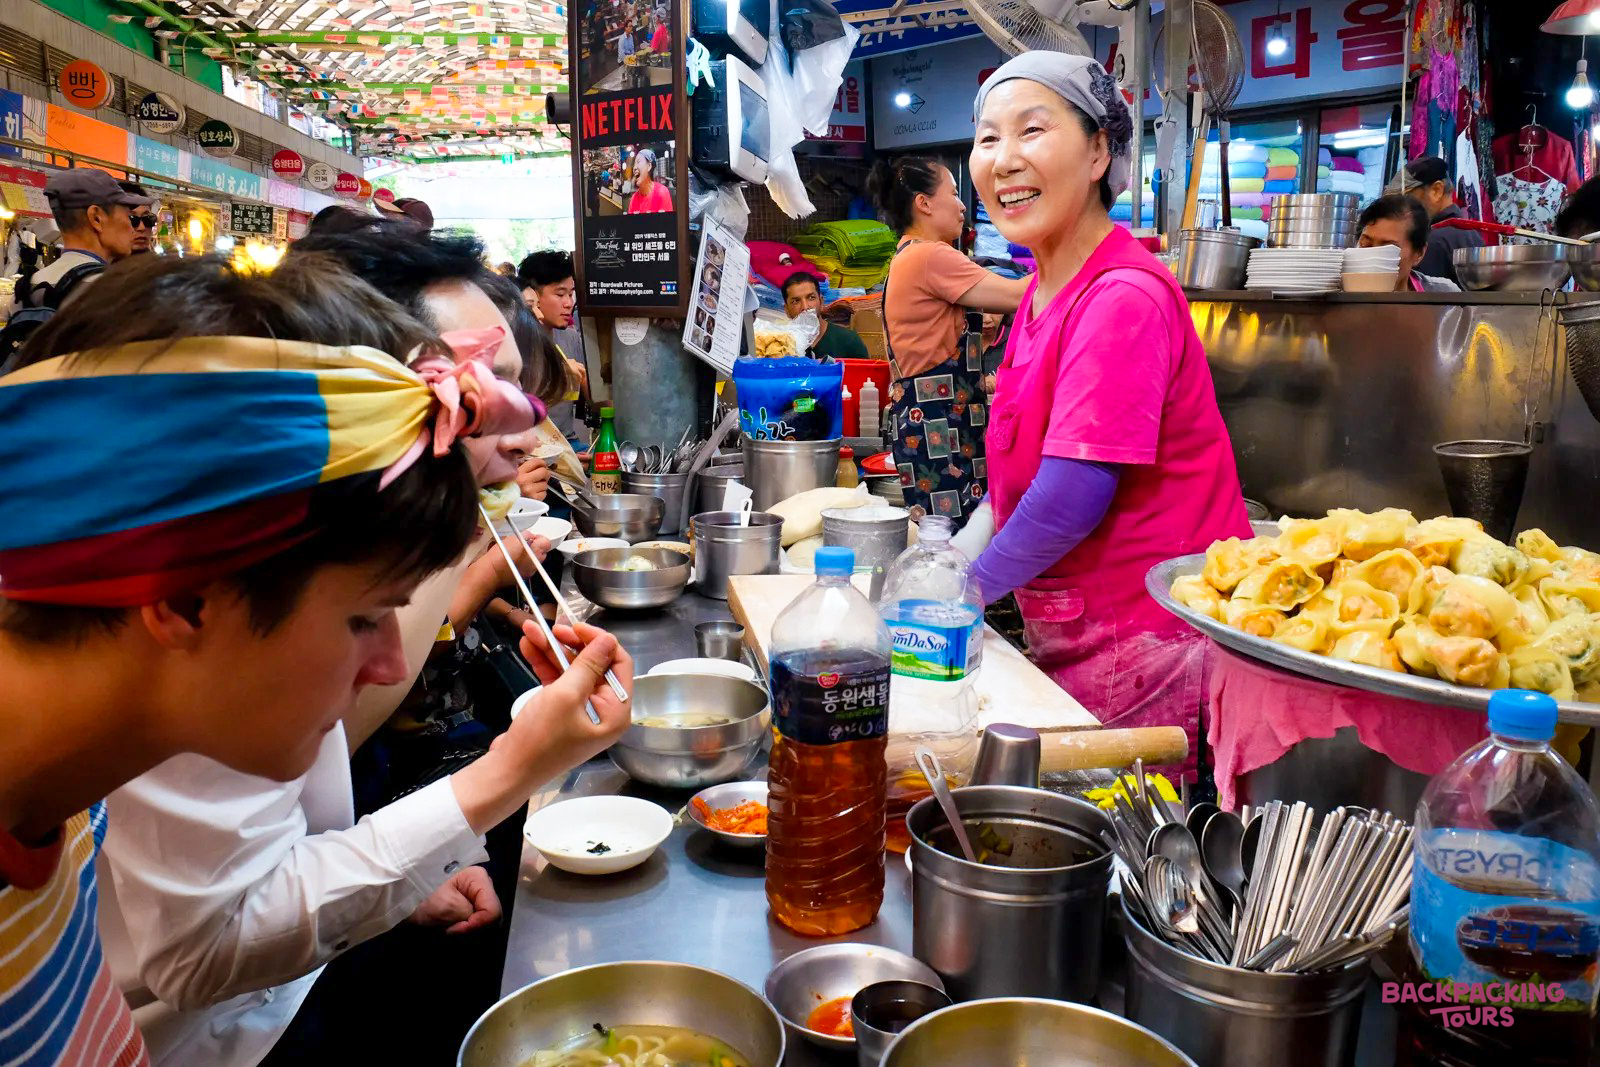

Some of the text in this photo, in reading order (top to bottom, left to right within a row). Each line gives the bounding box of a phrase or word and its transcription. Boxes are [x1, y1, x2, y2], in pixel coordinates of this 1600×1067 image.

[68, 71, 99, 98] 빵
[582, 93, 673, 139] NETFLIX
[632, 242, 643, 251] 위의
[632, 252, 670, 262] 대한민국 서울
[891, 631, 949, 651] amDaSoo
[821, 682, 888, 714] 동원샘물
